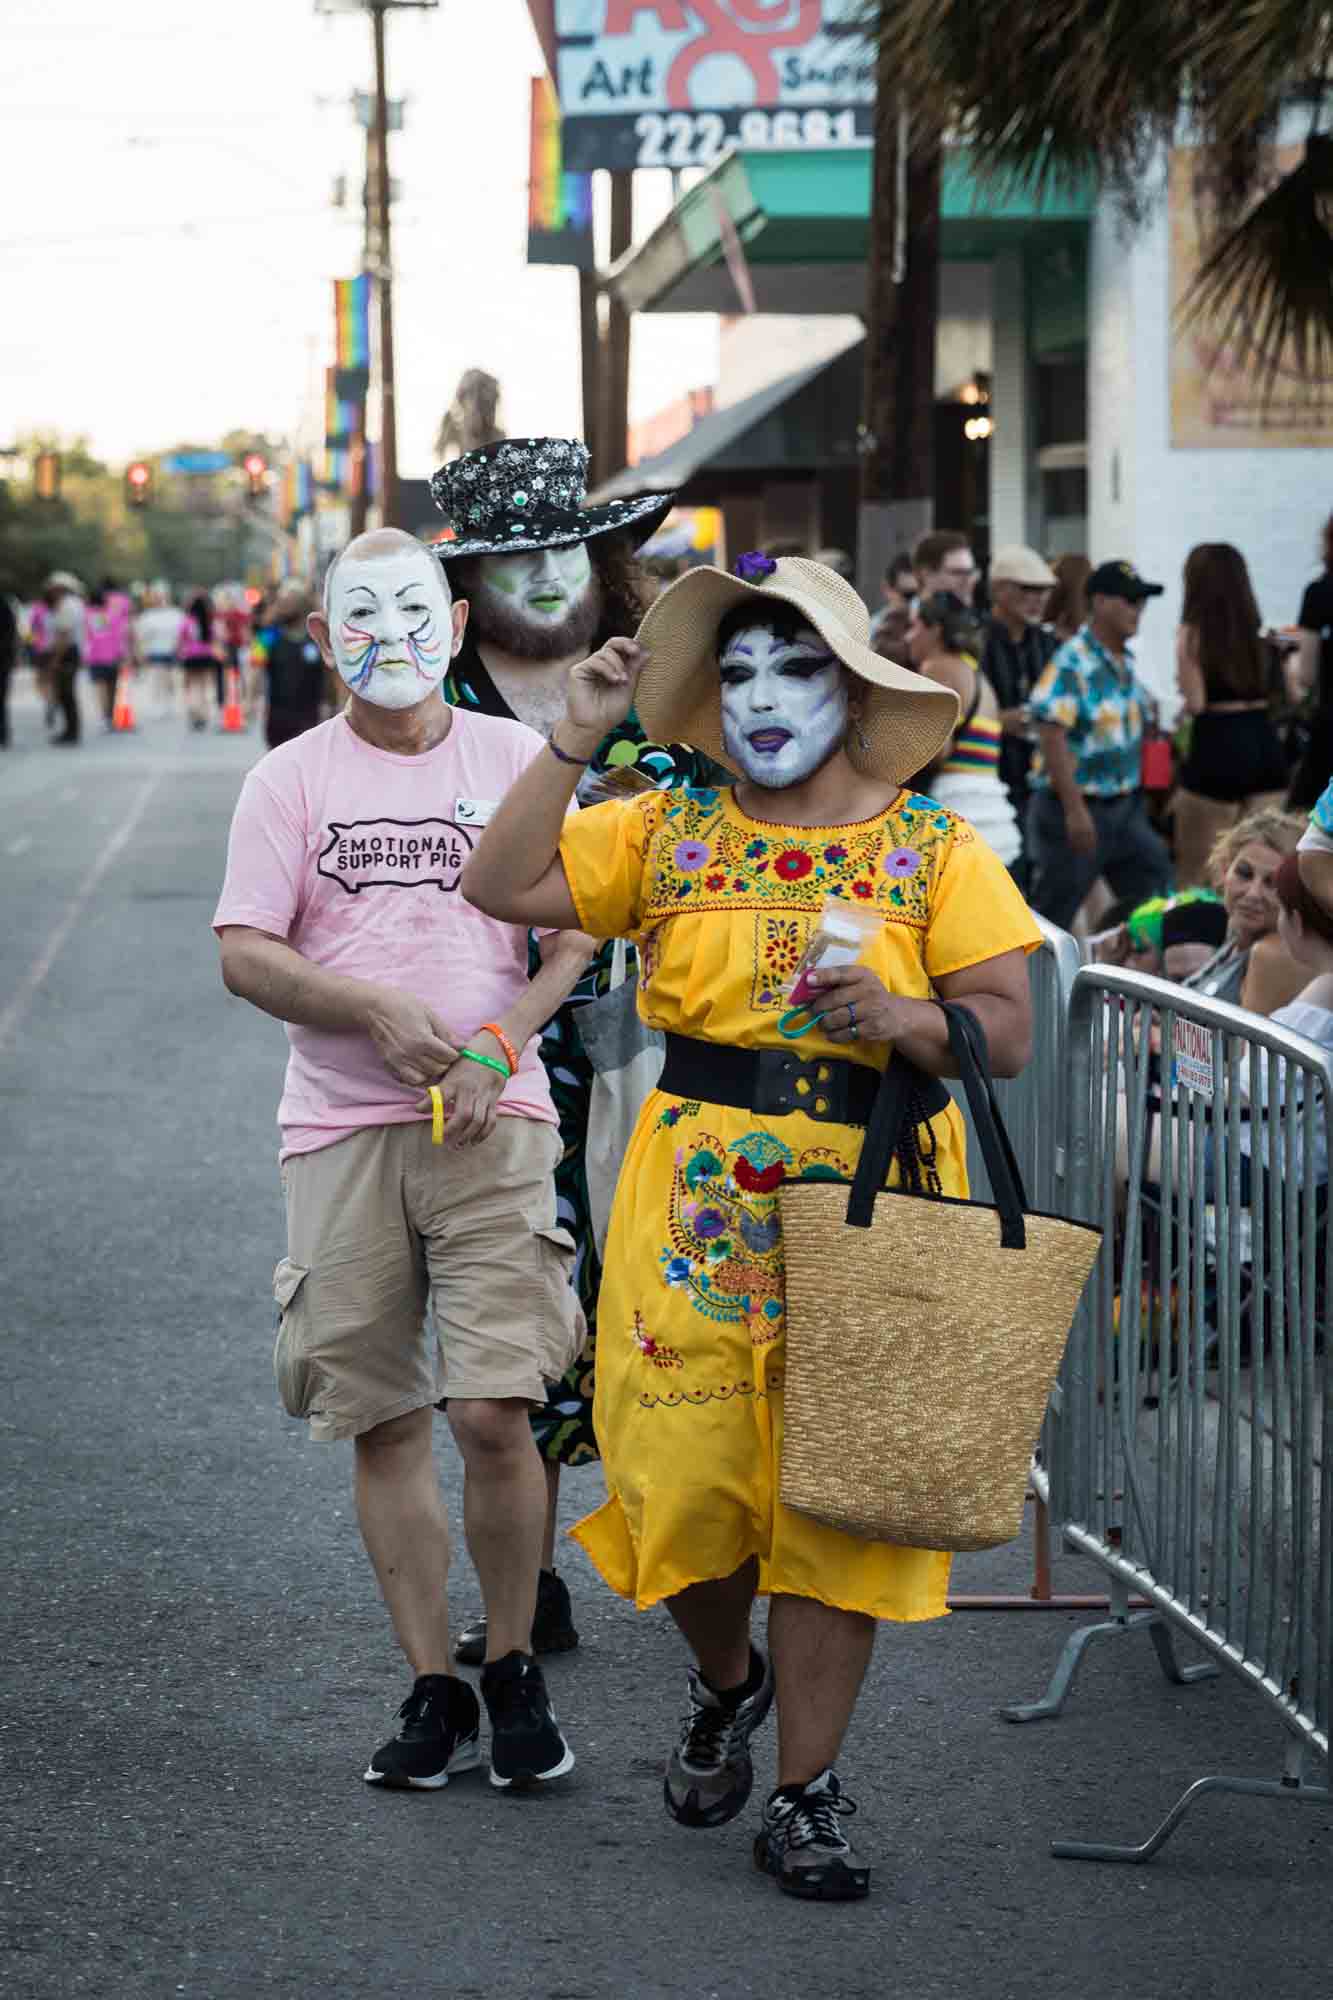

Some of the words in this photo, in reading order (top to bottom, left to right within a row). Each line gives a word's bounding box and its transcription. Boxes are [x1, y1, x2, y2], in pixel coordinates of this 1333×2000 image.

[582, 58, 655, 100] Art
[338, 837, 462, 854] EMOTIONAL
[337, 853, 423, 870] SUPPORT
[430, 852, 462, 869] PIG
